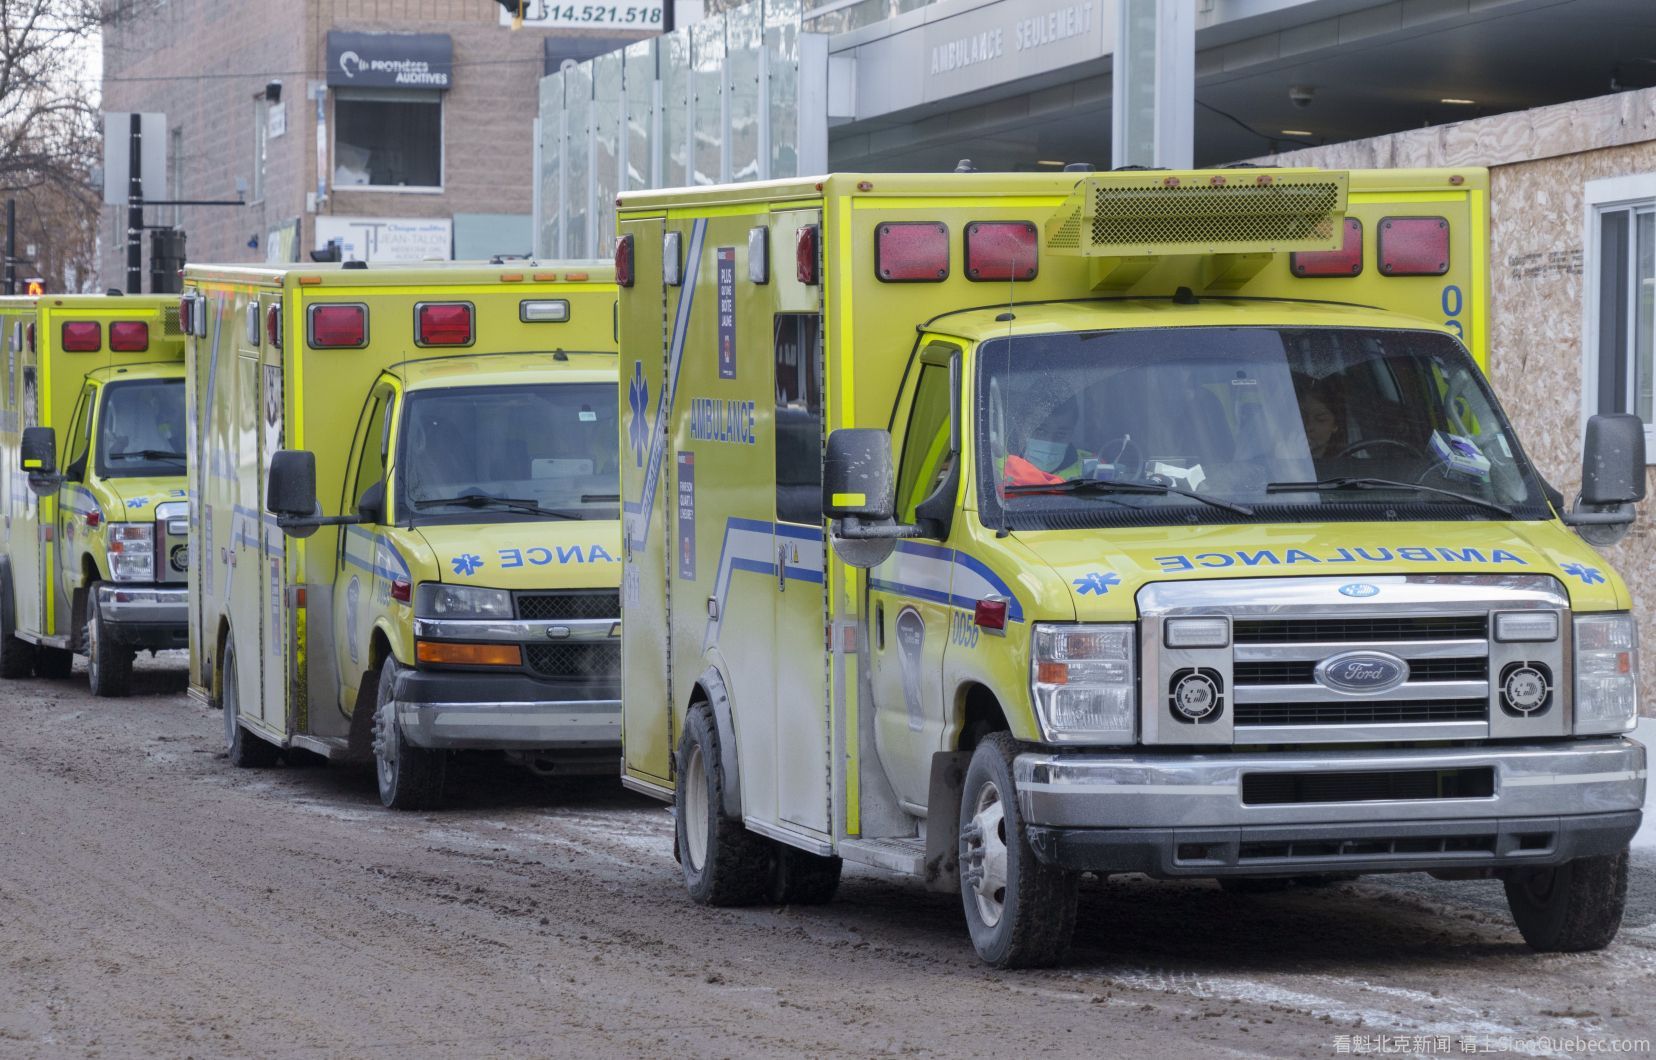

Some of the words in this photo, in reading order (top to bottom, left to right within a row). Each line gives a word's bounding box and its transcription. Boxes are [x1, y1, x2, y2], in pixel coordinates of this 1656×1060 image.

[931, 27, 1003, 76] AMBULANCE
[1016, 2, 1093, 51] SEULEMENT
[395, 72, 448, 85] AUDITIVES
[721, 268, 732, 283] PLUS
[690, 398, 755, 444] AMBULANCE
[953, 611, 979, 648] 0056
[1344, 662, 1384, 680] Ford
